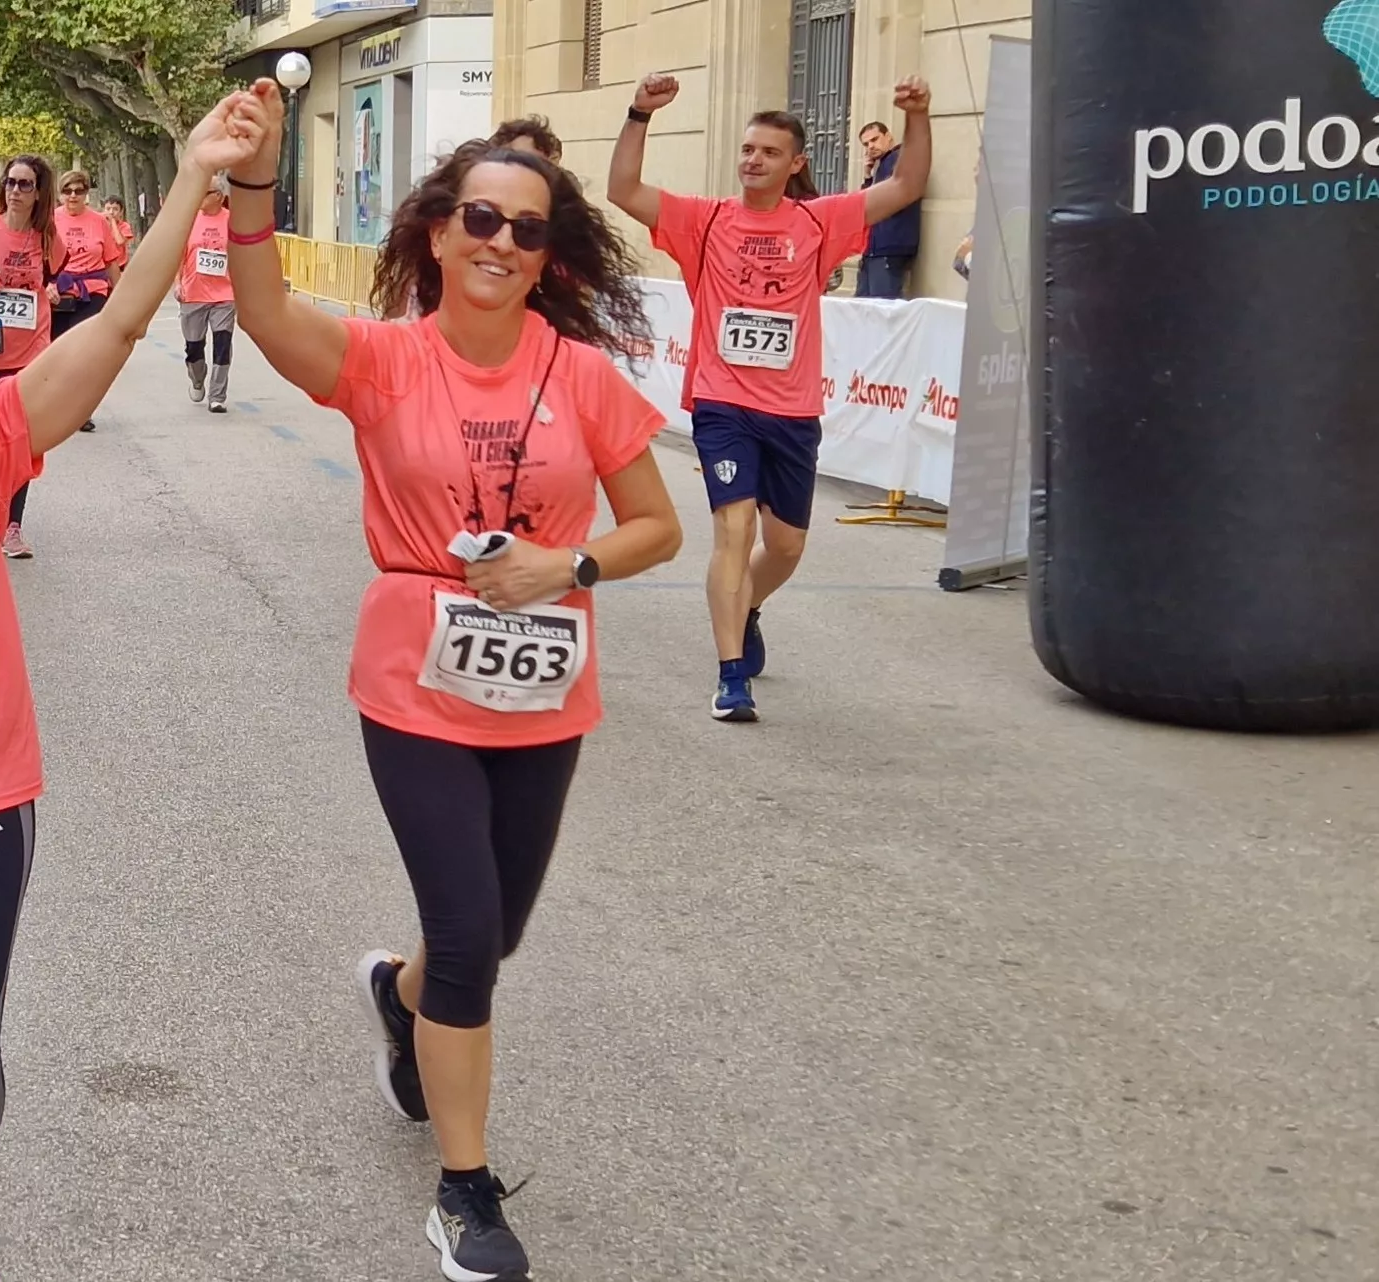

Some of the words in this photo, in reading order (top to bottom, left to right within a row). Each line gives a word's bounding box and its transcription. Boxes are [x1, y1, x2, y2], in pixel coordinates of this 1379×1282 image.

[1203, 173, 1379, 210] PODOLOGÍA
[199, 257, 224, 269] 2590
[728, 328, 789, 353] 1573
[921, 377, 961, 420] Alca
[455, 613, 507, 632] CONTRA
[509, 621, 523, 634] EL
[523, 621, 573, 640] CÁNCER
[450, 634, 570, 683] 1563
